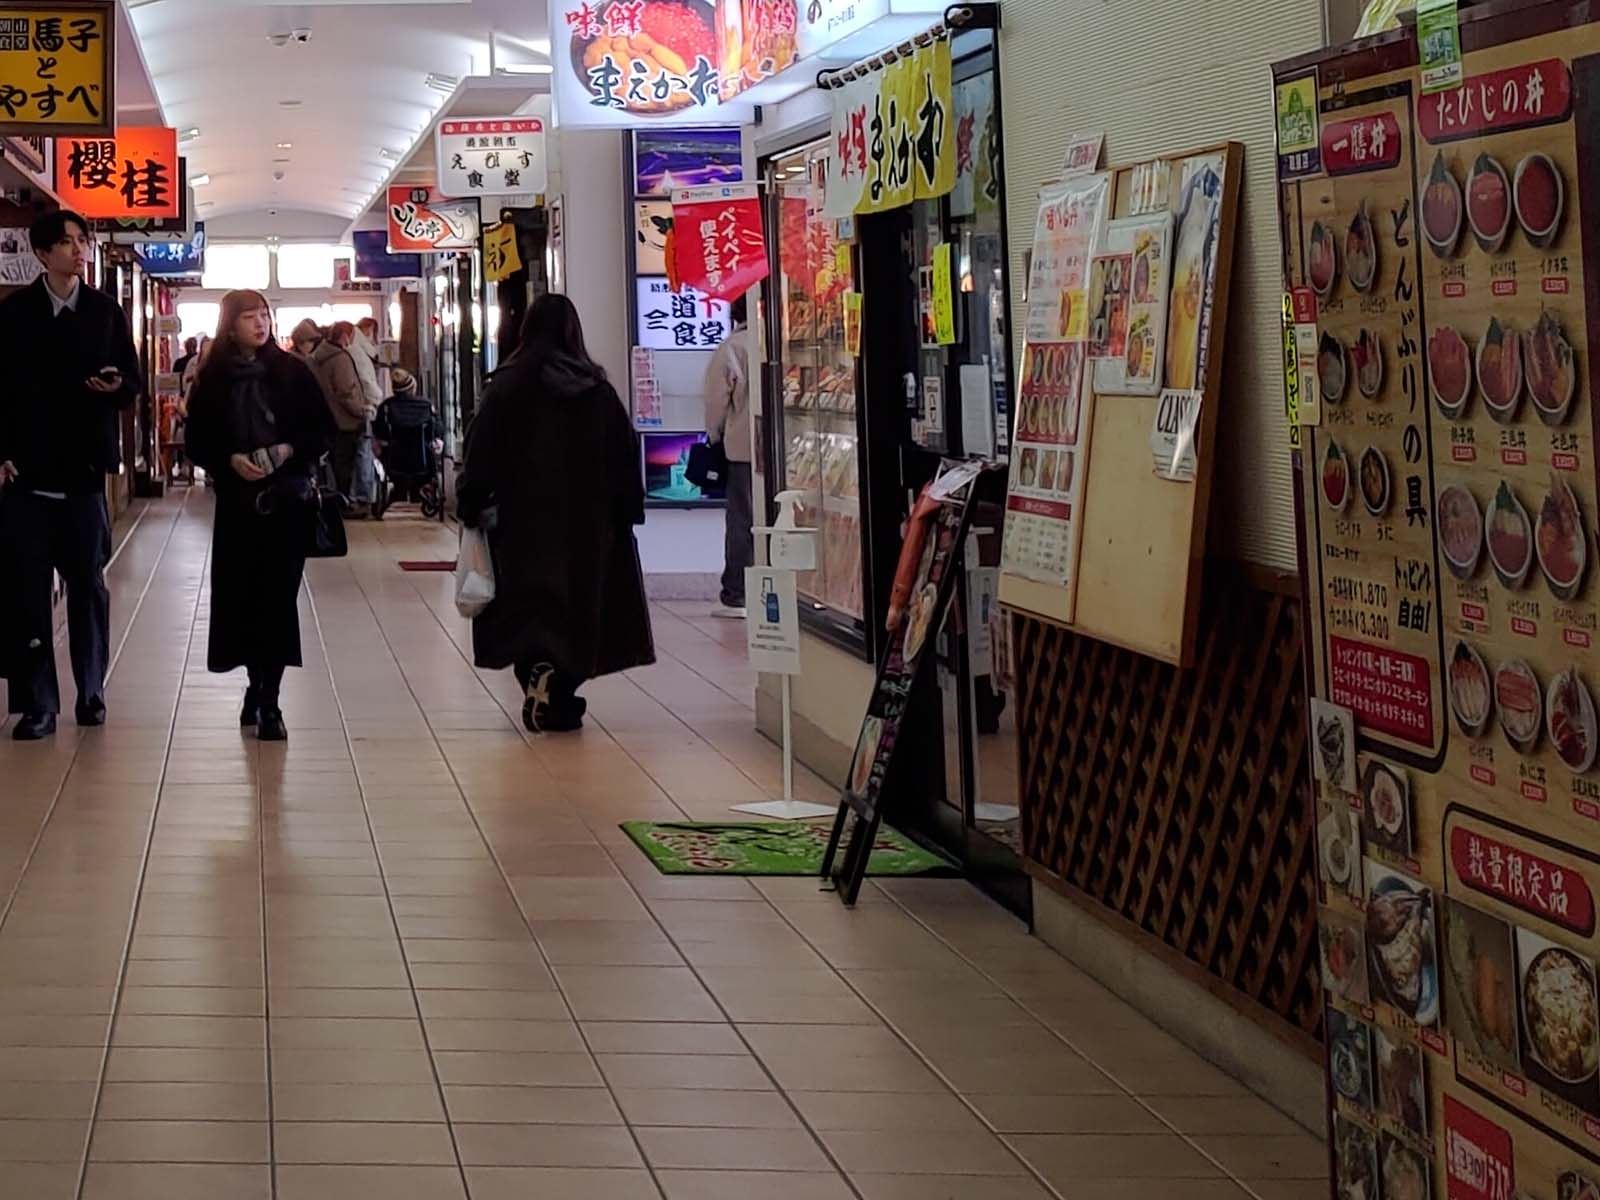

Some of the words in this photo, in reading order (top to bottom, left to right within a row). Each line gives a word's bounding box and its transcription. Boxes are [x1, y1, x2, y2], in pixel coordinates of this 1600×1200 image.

[32, 17, 100, 53] 馬子
[564, 0, 644, 37] 味鮮
[36, 57, 57, 80] と
[1435, 68, 1545, 131] たびじの丼
[68, 140, 171, 209] 櫻桂
[451, 150, 534, 171] えびす
[467, 168, 521, 189] 食堂
[717, 205, 743, 273] ペイペイ
[671, 321, 725, 346] 食堂
[1467, 837, 1569, 917] 数量限定品
